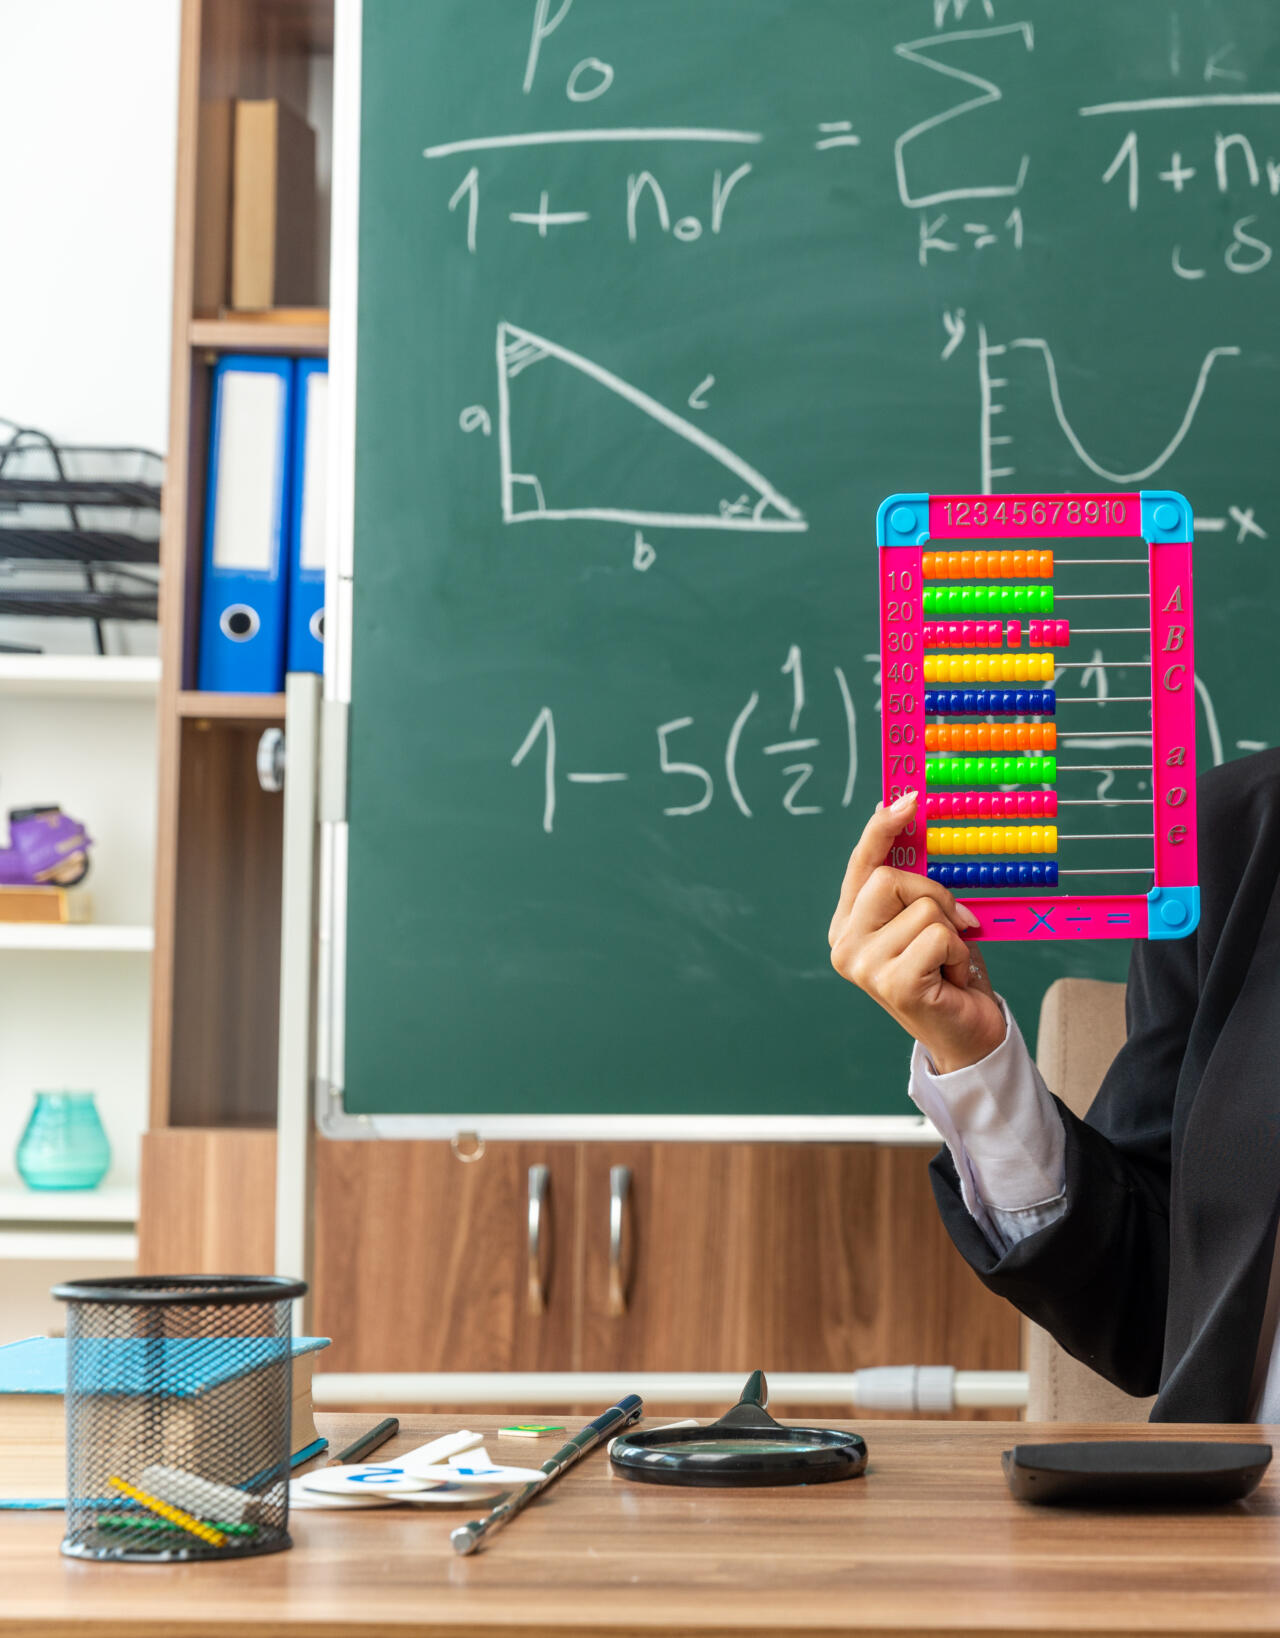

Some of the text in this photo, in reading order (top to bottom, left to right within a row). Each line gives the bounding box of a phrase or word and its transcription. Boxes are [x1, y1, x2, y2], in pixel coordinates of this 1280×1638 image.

[888, 570, 913, 594] 10
[887, 602, 914, 622] 20
[887, 632, 914, 652] 30
[1162, 586, 1186, 691] A B C
[887, 663, 915, 684] 40
[888, 693, 915, 713] 50
[889, 724, 916, 744] 60
[889, 755, 916, 775] 70
